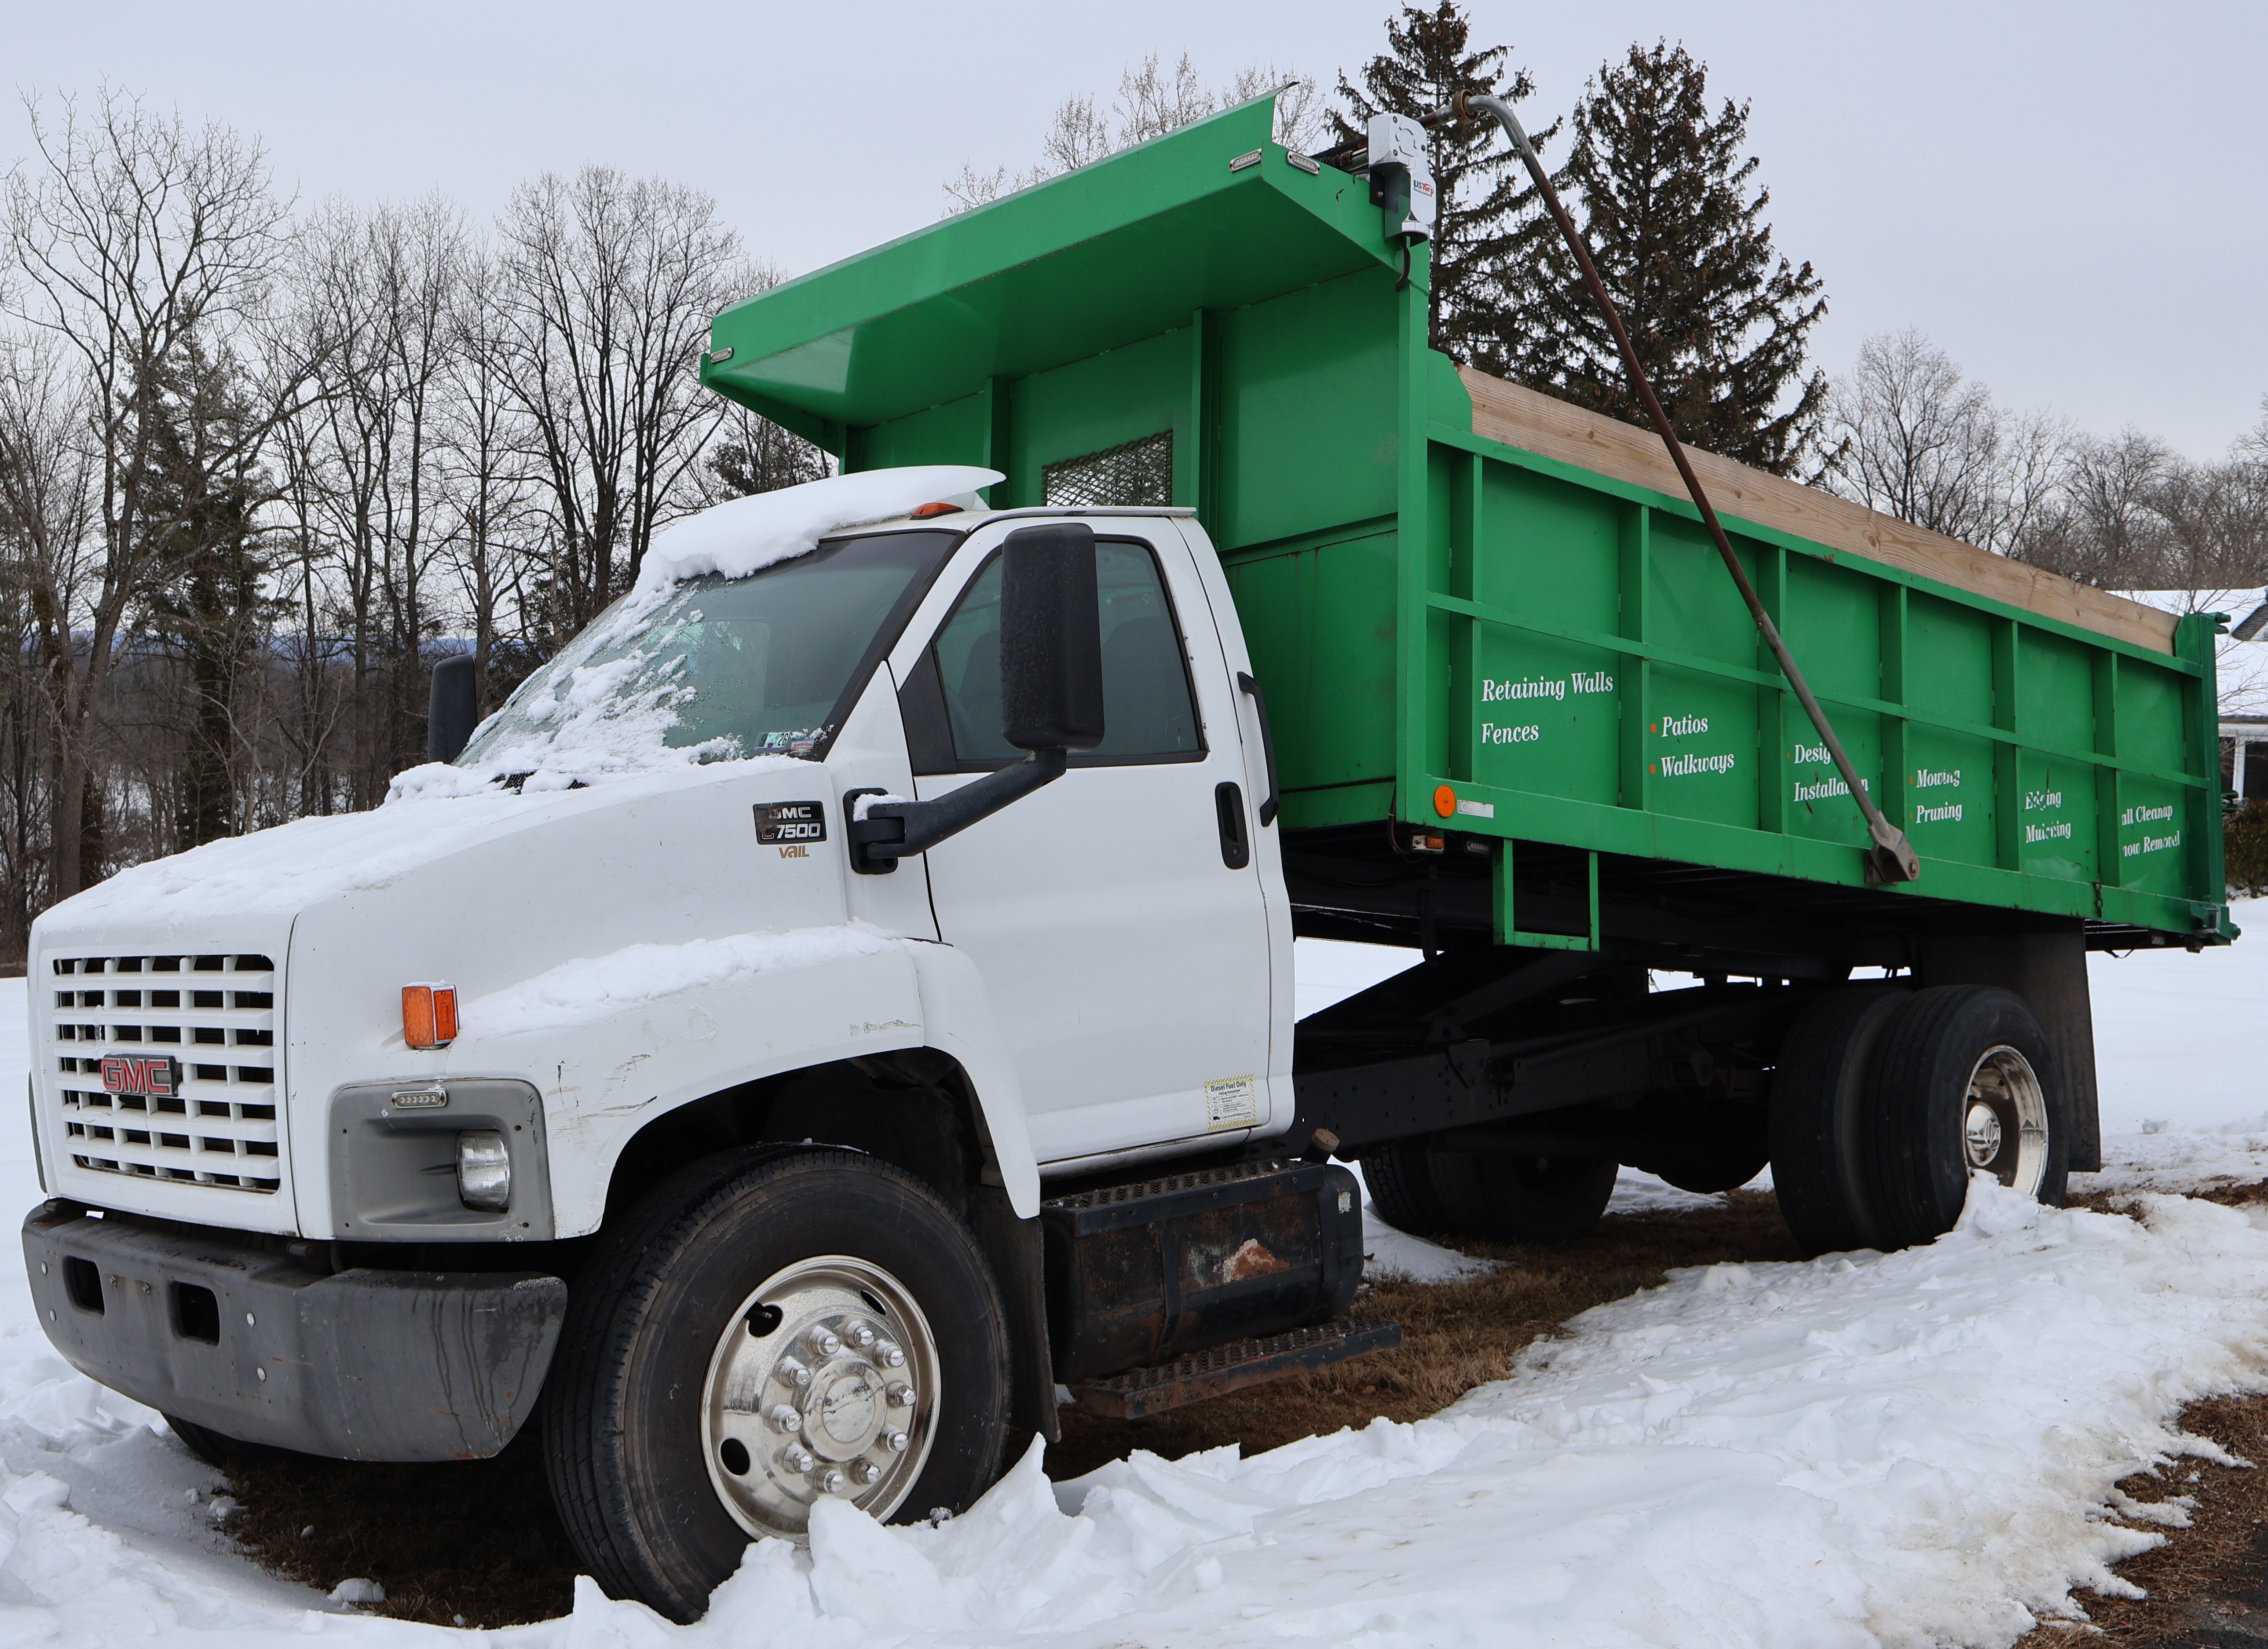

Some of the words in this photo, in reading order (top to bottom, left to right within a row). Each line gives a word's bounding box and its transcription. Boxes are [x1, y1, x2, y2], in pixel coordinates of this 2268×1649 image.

[1481, 675, 1565, 702] Retaining
[1571, 671, 1613, 694] Walls
[1482, 723, 1539, 744] Fences
[1661, 714, 1708, 737] Patios
[778, 733, 789, 746] 26
[1794, 742, 1833, 764] Desig
[1661, 753, 1734, 777] Walkways
[1916, 768, 1961, 788] Mowing
[1793, 778, 1869, 802] Installatn
[1916, 801, 1963, 823] Pruning
[2136, 805, 2173, 823] Cleanup
[101, 1057, 172, 1095] GMC
